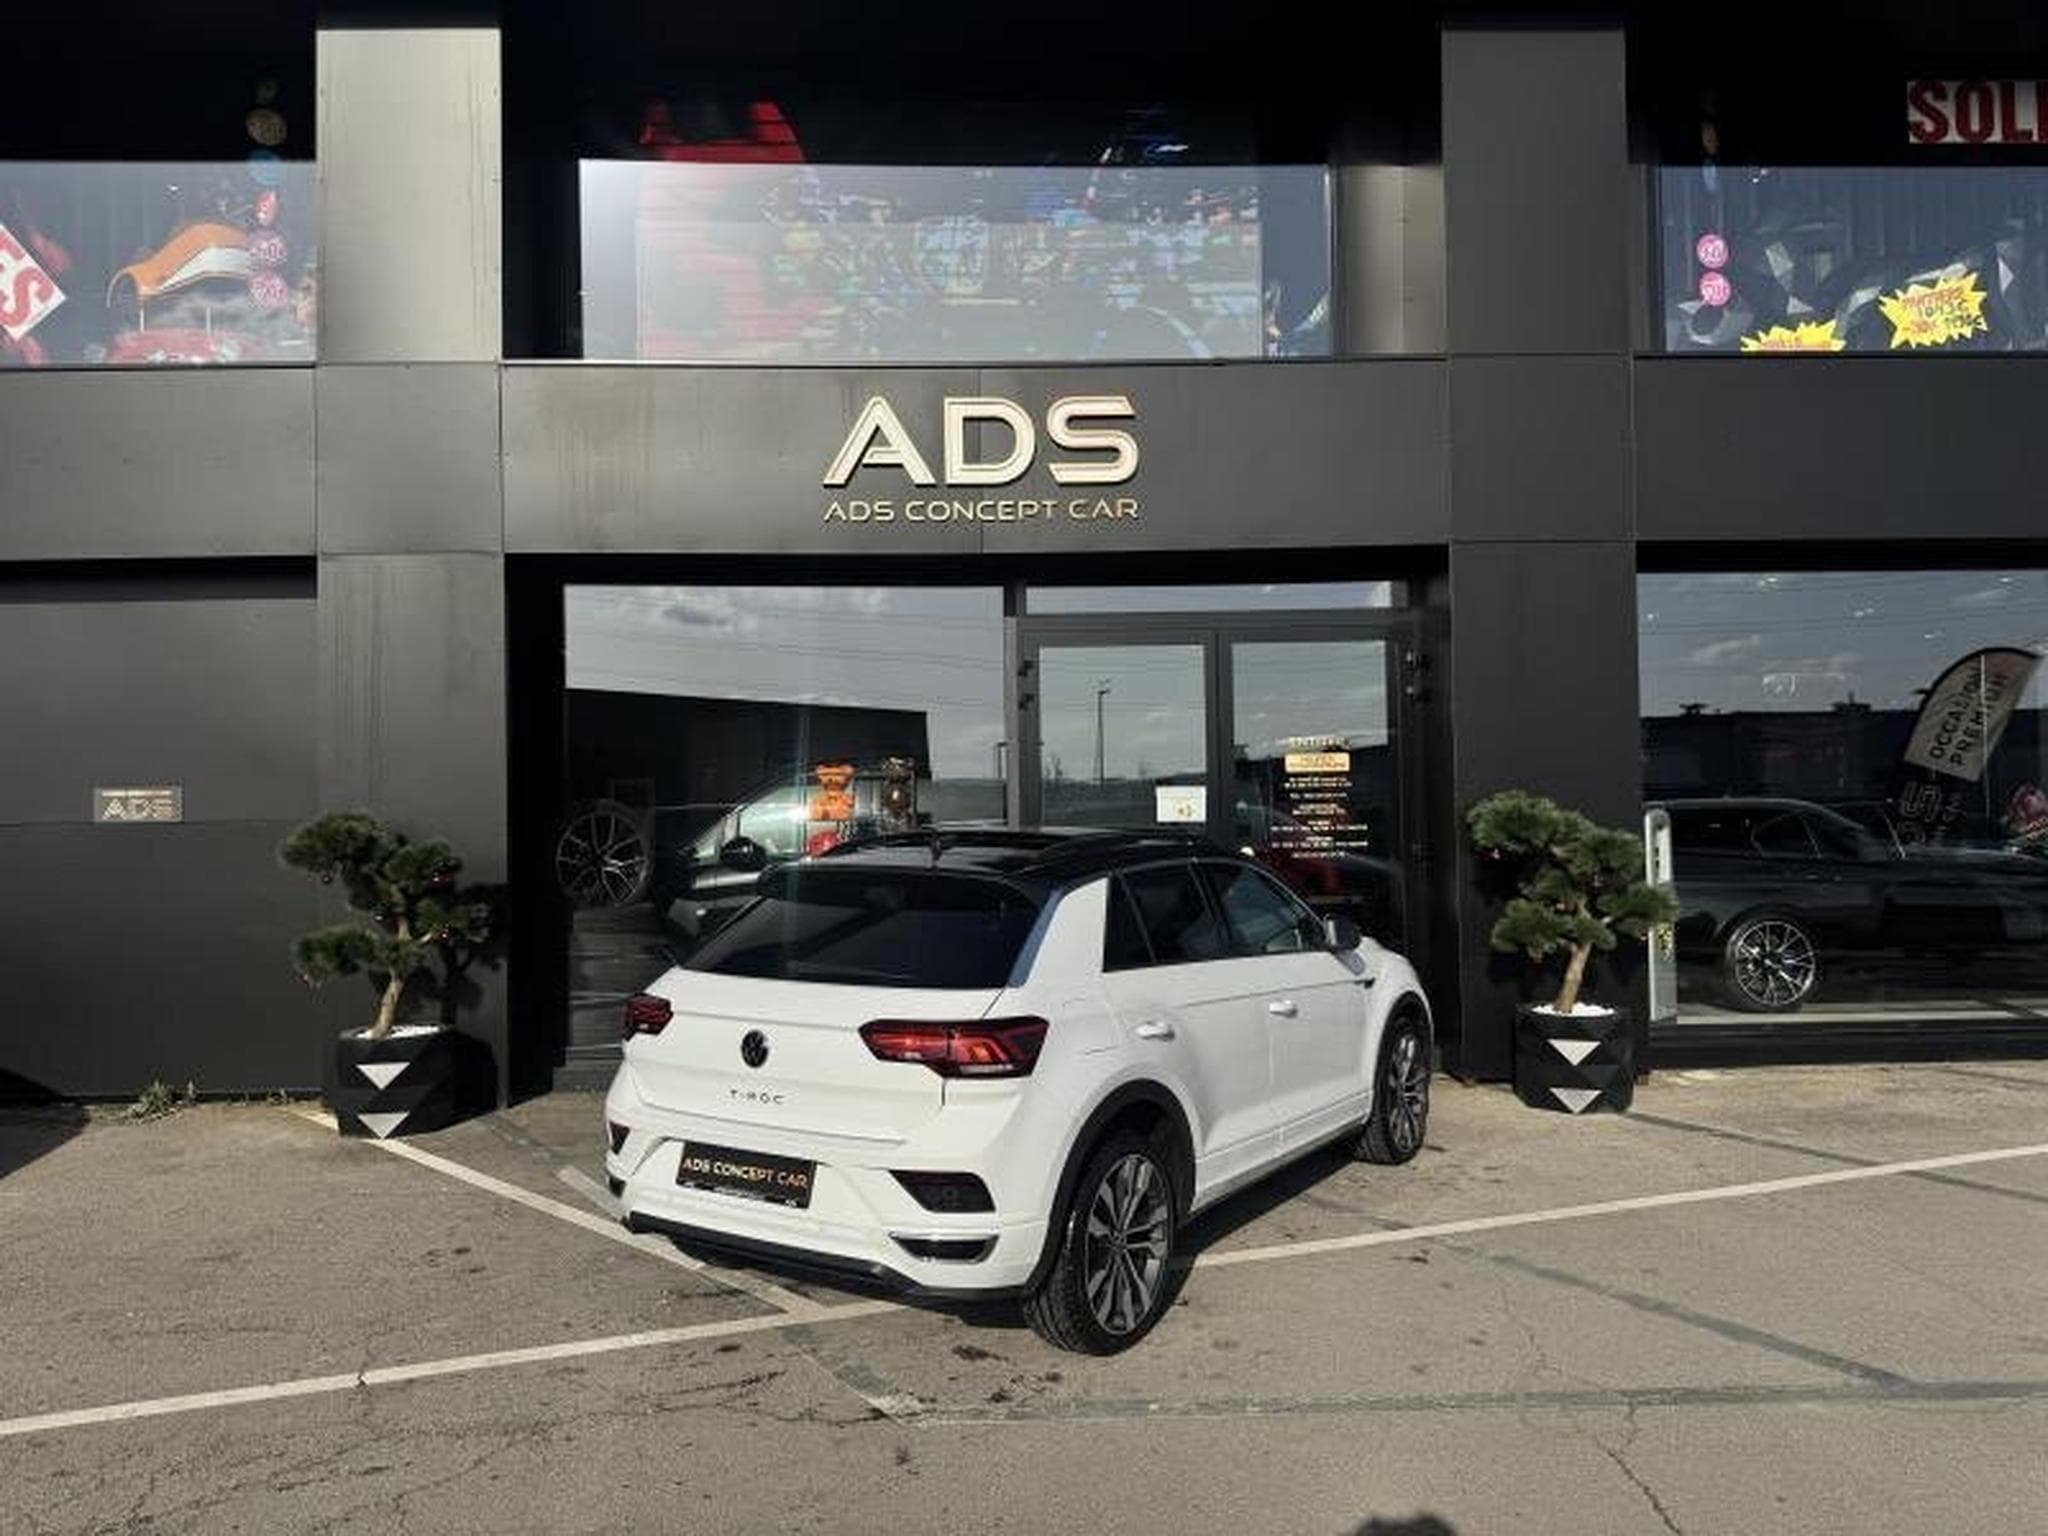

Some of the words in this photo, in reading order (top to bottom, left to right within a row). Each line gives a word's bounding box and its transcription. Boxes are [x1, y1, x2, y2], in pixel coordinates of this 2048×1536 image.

[823, 396, 1139, 486] ADS
[824, 500, 895, 521] ADS
[905, 500, 1057, 520] CONCEPT
[1069, 499, 1138, 519] CAR
[683, 1157, 711, 1173] ADS
[714, 1162, 774, 1183] CONCEPT
[777, 1172, 808, 1189] CAR
